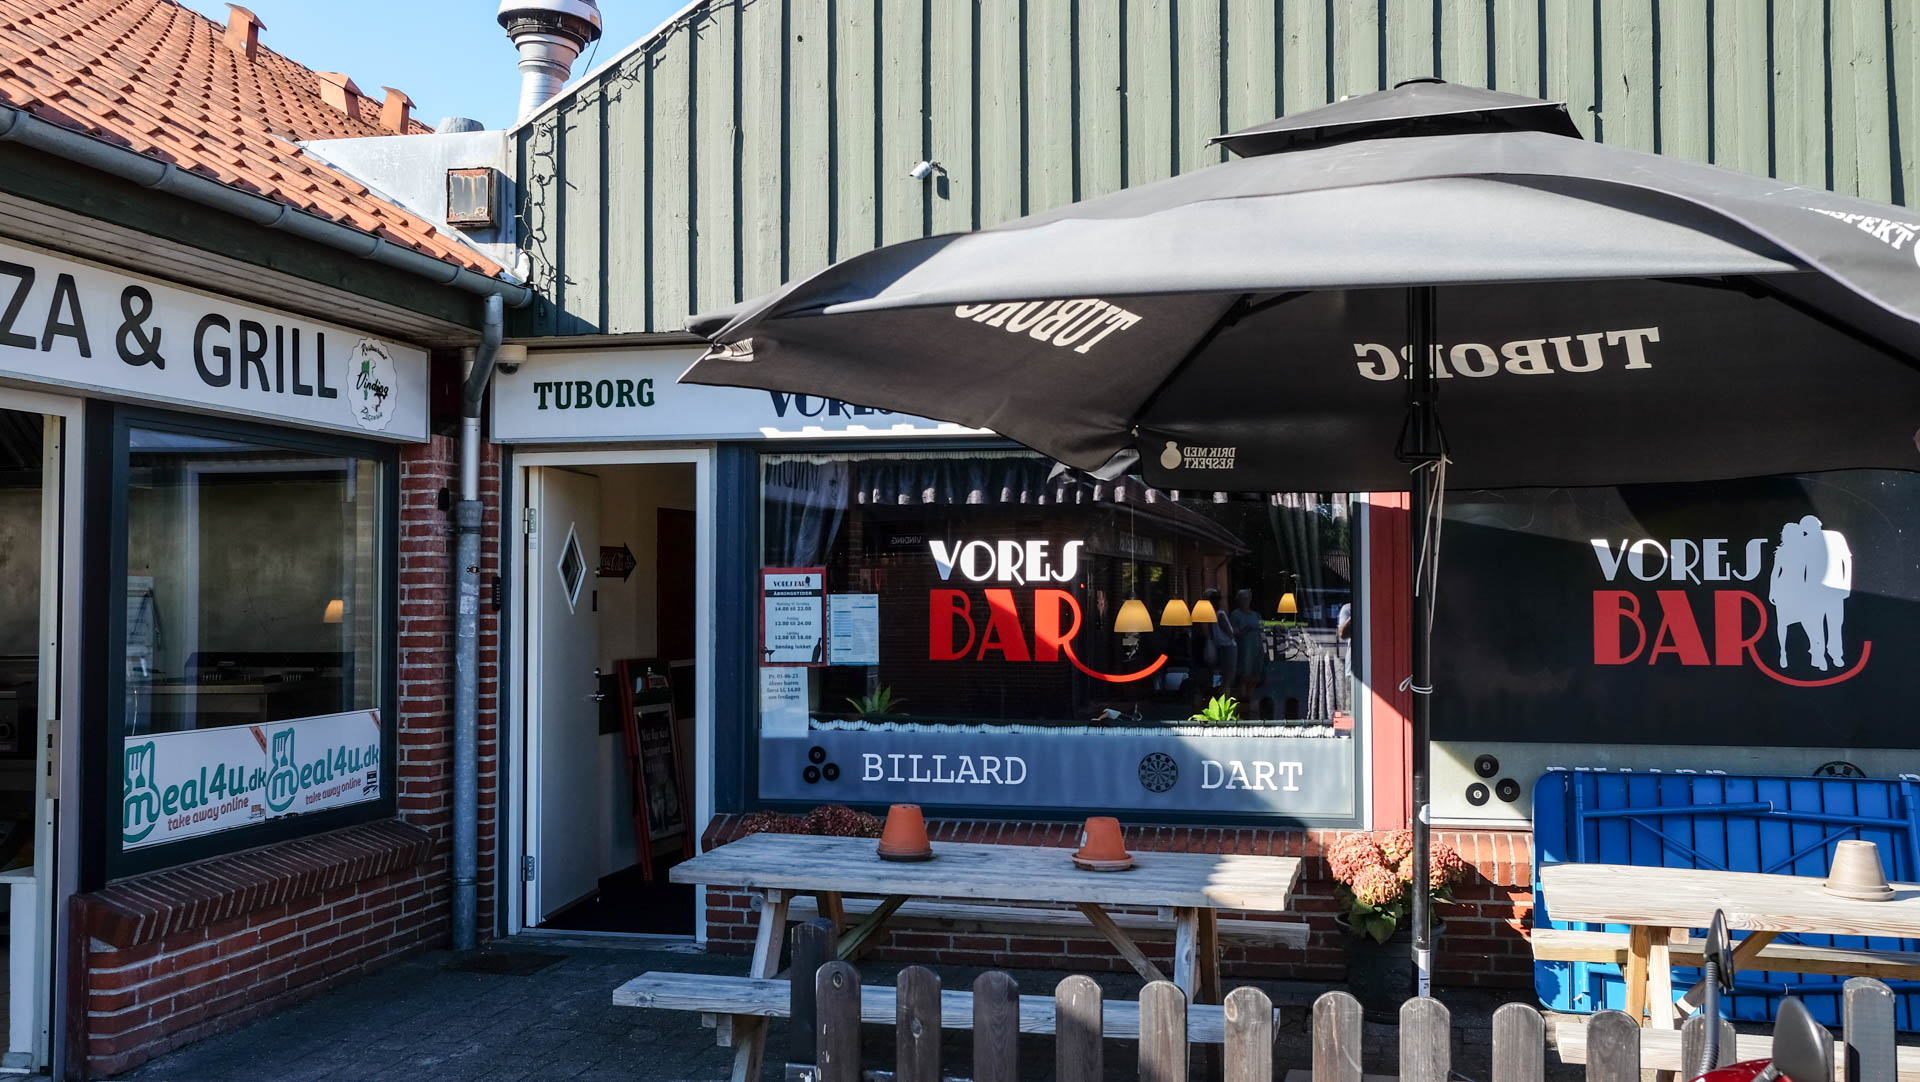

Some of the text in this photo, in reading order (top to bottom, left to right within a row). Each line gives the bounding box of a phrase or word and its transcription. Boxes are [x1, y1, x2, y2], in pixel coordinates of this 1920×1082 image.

[115, 285, 166, 370] &
[193, 313, 338, 399] GRILL
[533, 378, 655, 411] TUBORG
[928, 540, 1084, 586] VORES
[1590, 538, 1769, 585] VORES
[929, 588, 1169, 683] BAR
[1593, 590, 1873, 688] BAR
[306, 778, 362, 805] take away online
[862, 753, 1303, 792] BILLARD DART
[168, 796, 249, 831] take away online
